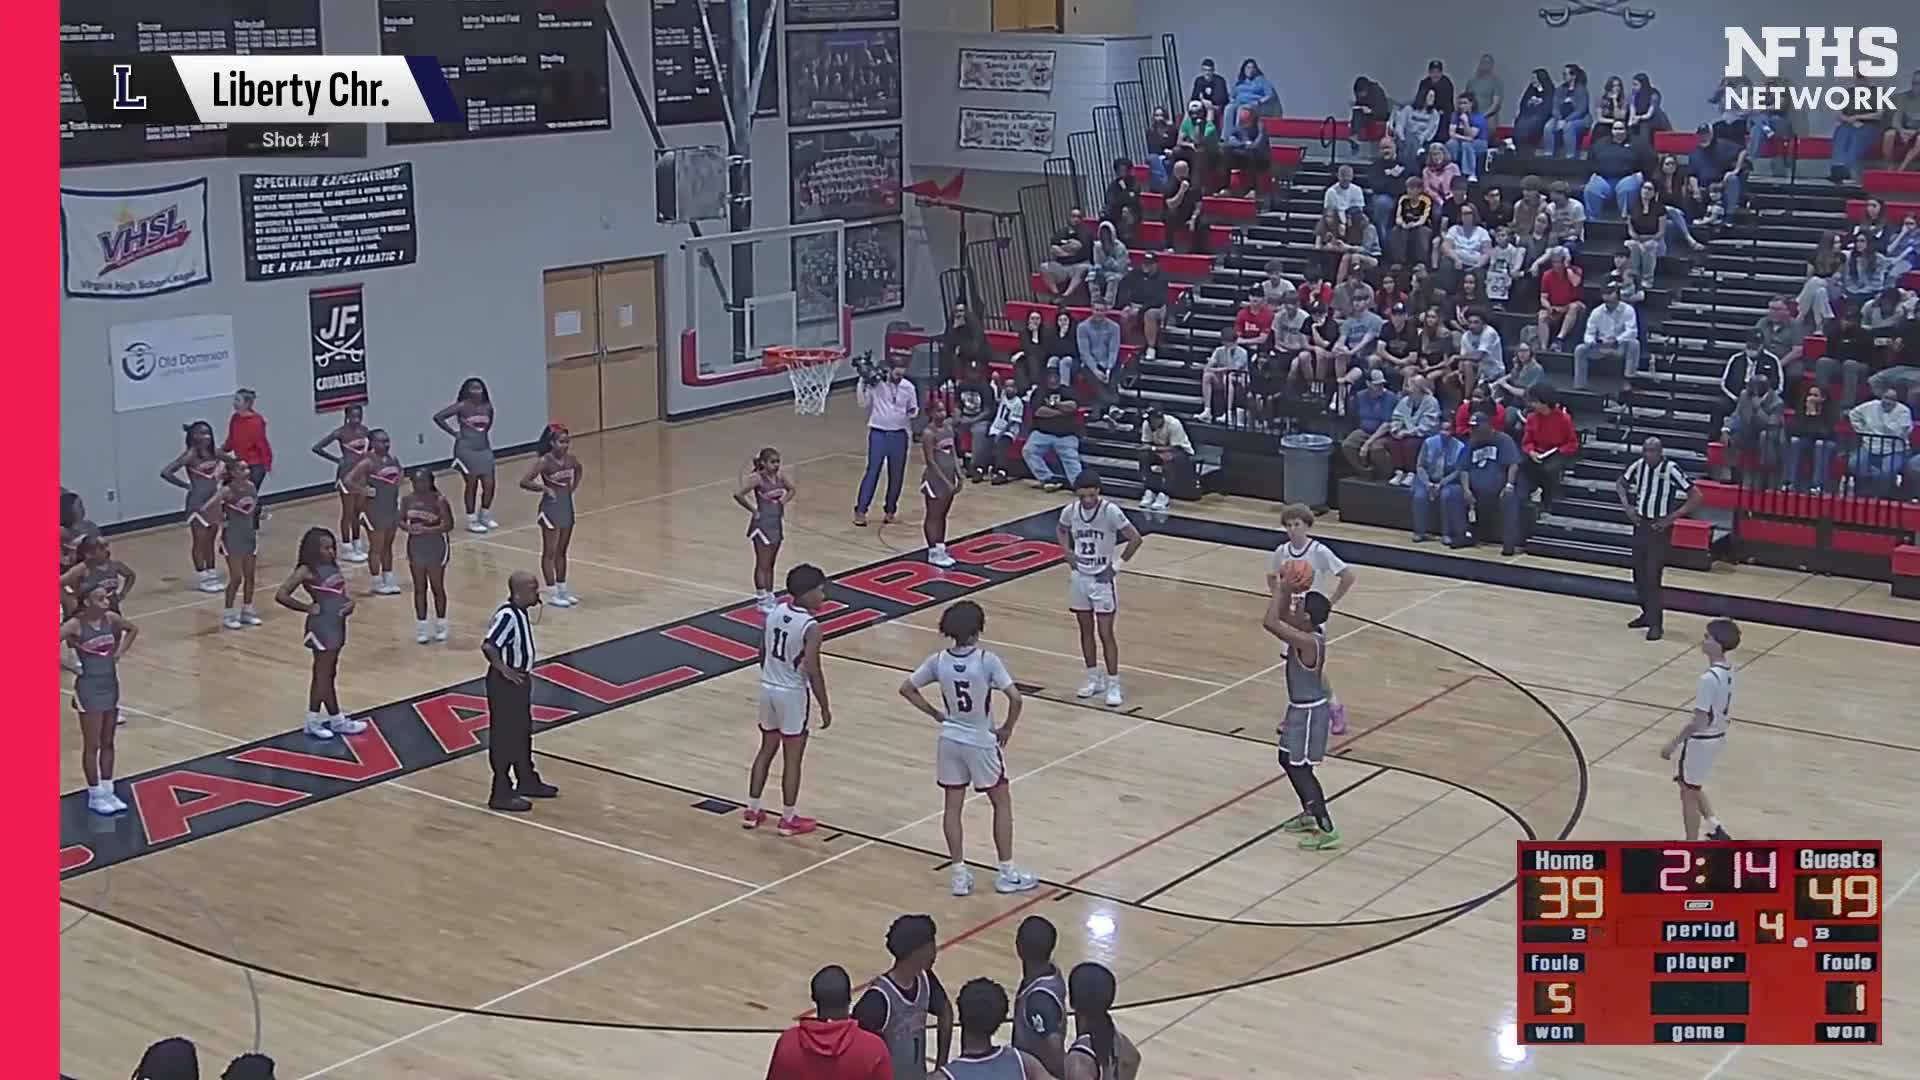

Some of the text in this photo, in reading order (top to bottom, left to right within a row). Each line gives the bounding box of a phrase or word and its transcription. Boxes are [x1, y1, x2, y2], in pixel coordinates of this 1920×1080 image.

[321, 166, 401, 187] EXPECTATIONS
[97, 204, 188, 263] VHSL
[320, 304, 360, 340] JF
[1081, 542, 1096, 555] 23
[772, 627, 788, 663] 11
[61, 533, 1066, 873] AVALIERS
[953, 680, 973, 714] 5
